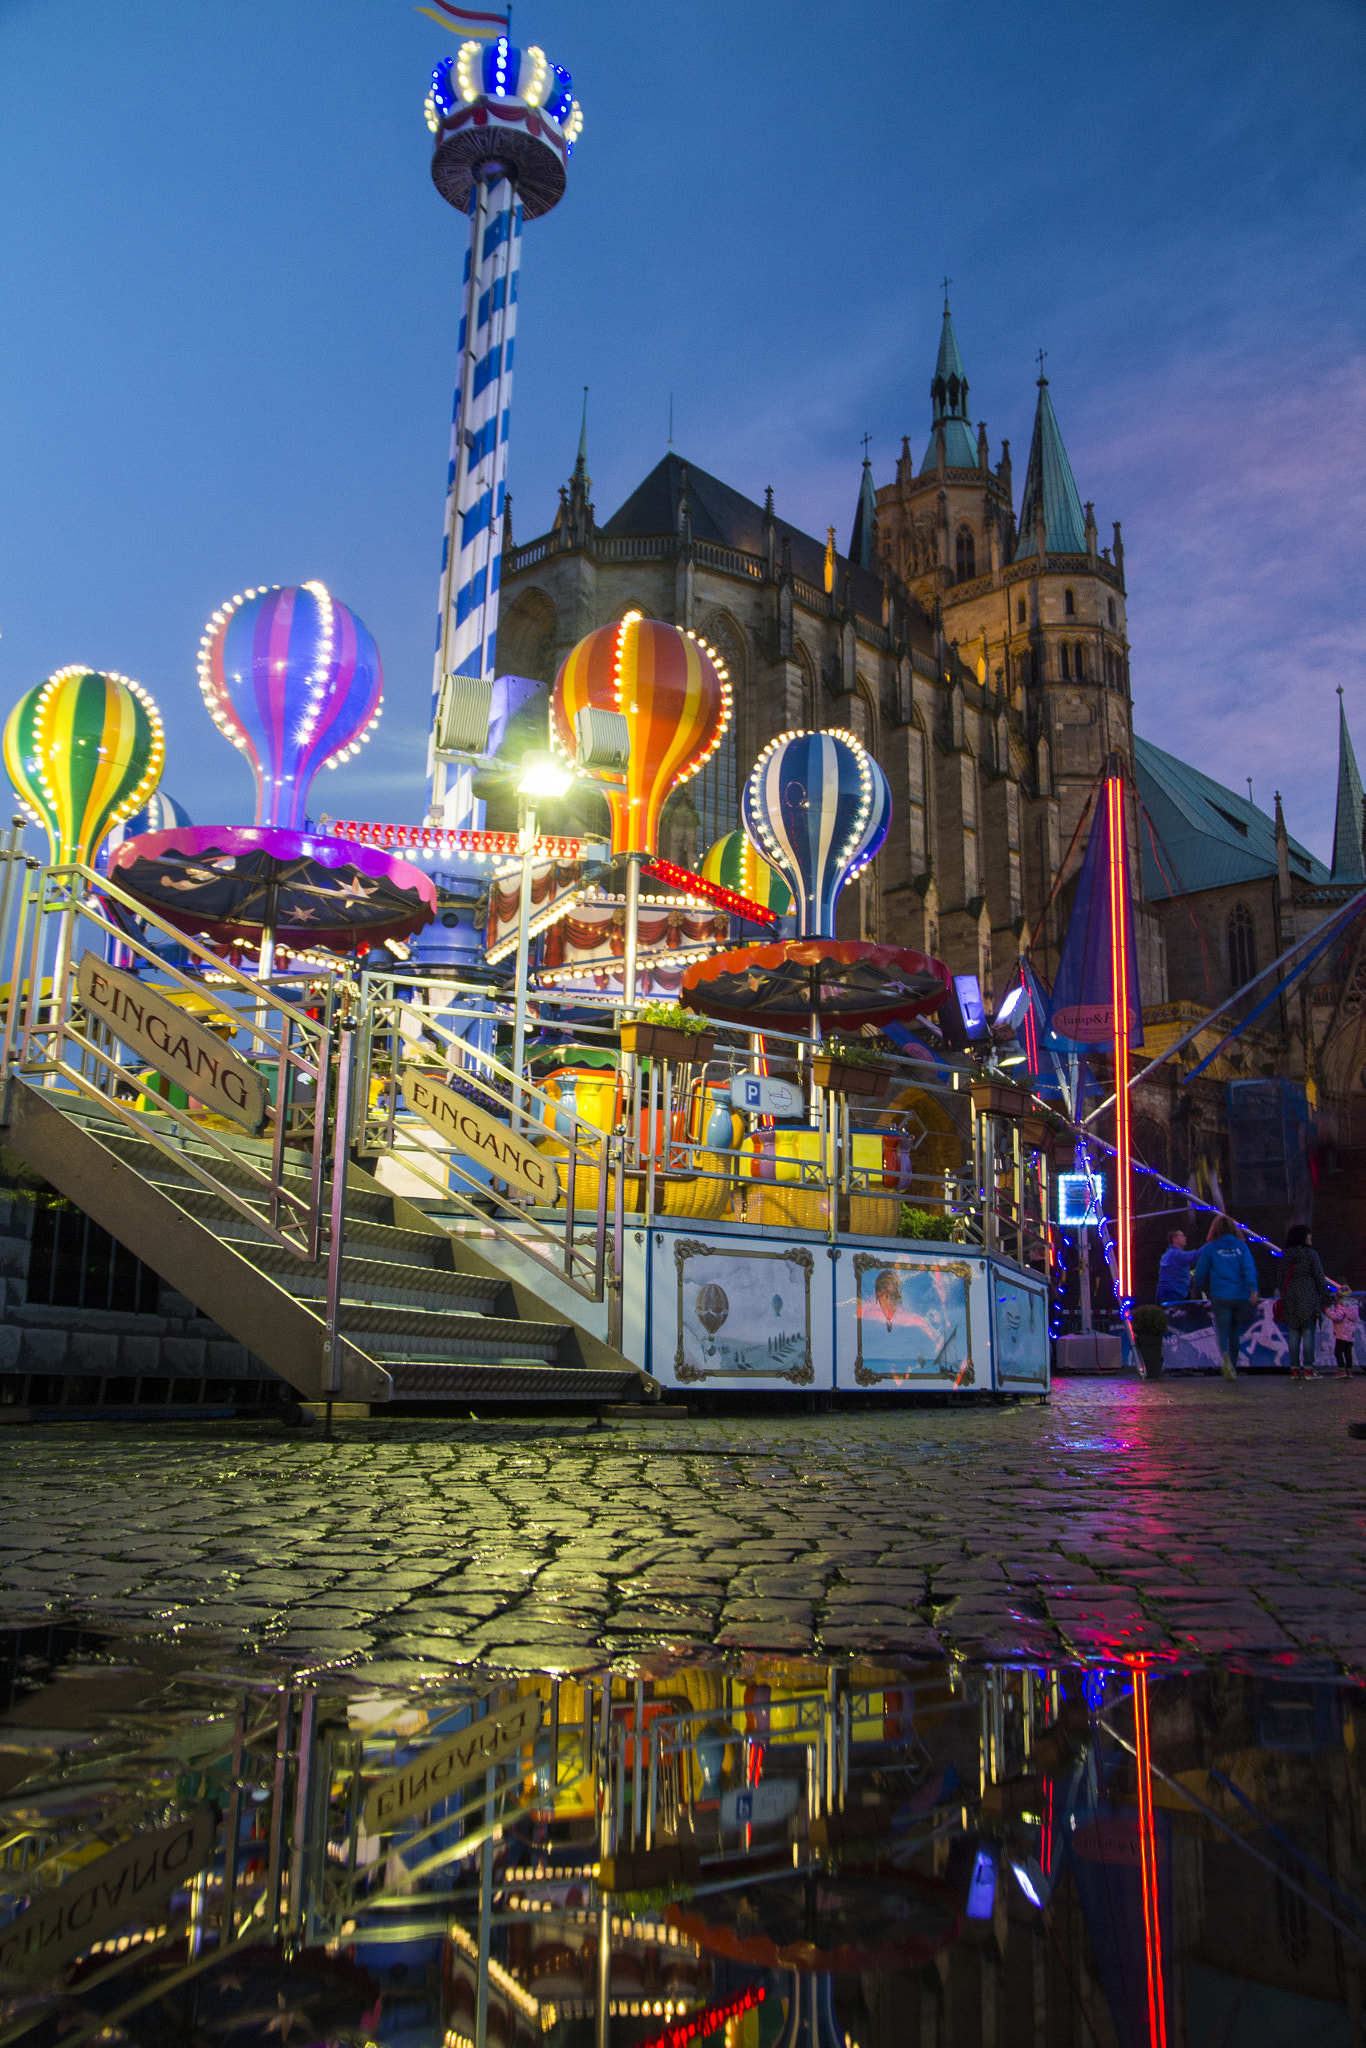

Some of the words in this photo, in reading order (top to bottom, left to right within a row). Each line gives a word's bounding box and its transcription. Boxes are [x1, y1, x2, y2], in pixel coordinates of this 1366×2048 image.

[89, 970, 249, 1111] EINGANG
[747, 1084, 759, 1101] P
[413, 1082, 545, 1190] EINGANG
[325, 1319, 333, 1331] 6
[323, 1340, 332, 1353] 6
